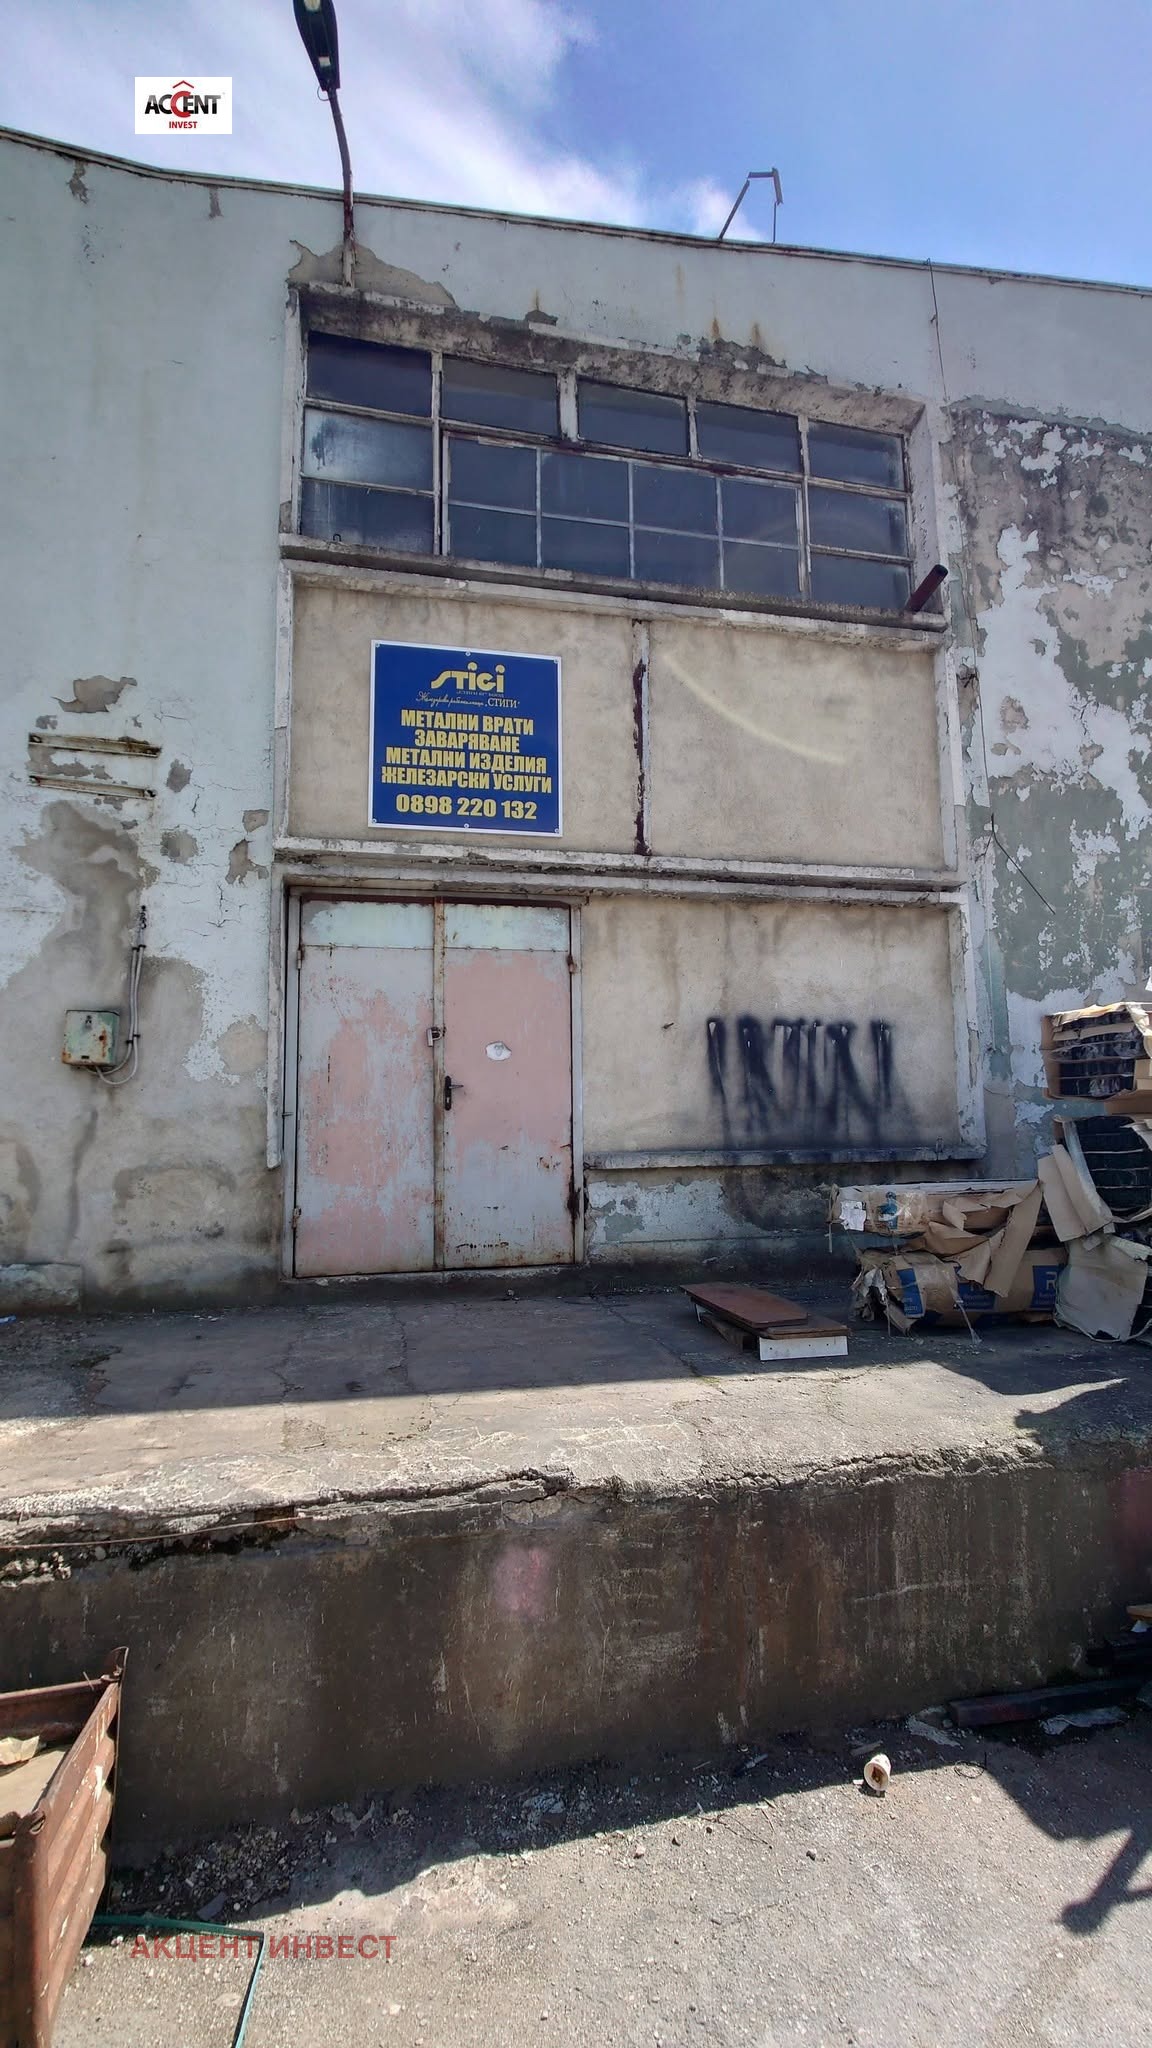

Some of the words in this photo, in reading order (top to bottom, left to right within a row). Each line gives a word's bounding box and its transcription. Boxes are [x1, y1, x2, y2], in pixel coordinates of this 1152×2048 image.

[401, 709, 479, 732] МЕТАЛНИ
[482, 715, 534, 736] ВРАТИ
[414, 729, 520, 753] ЗАВАРЯВАНЕ
[386, 746, 466, 769] МЕТАЛНИ
[469, 752, 547, 774] ИЗДЕЛИЯ
[381, 766, 490, 790] ЖЕЛЕЗАРСКИ
[493, 773, 552, 794] УСЛУГИ
[395, 793, 453, 814] 0898
[456, 797, 497, 818] 220
[500, 801, 538, 820] 132
